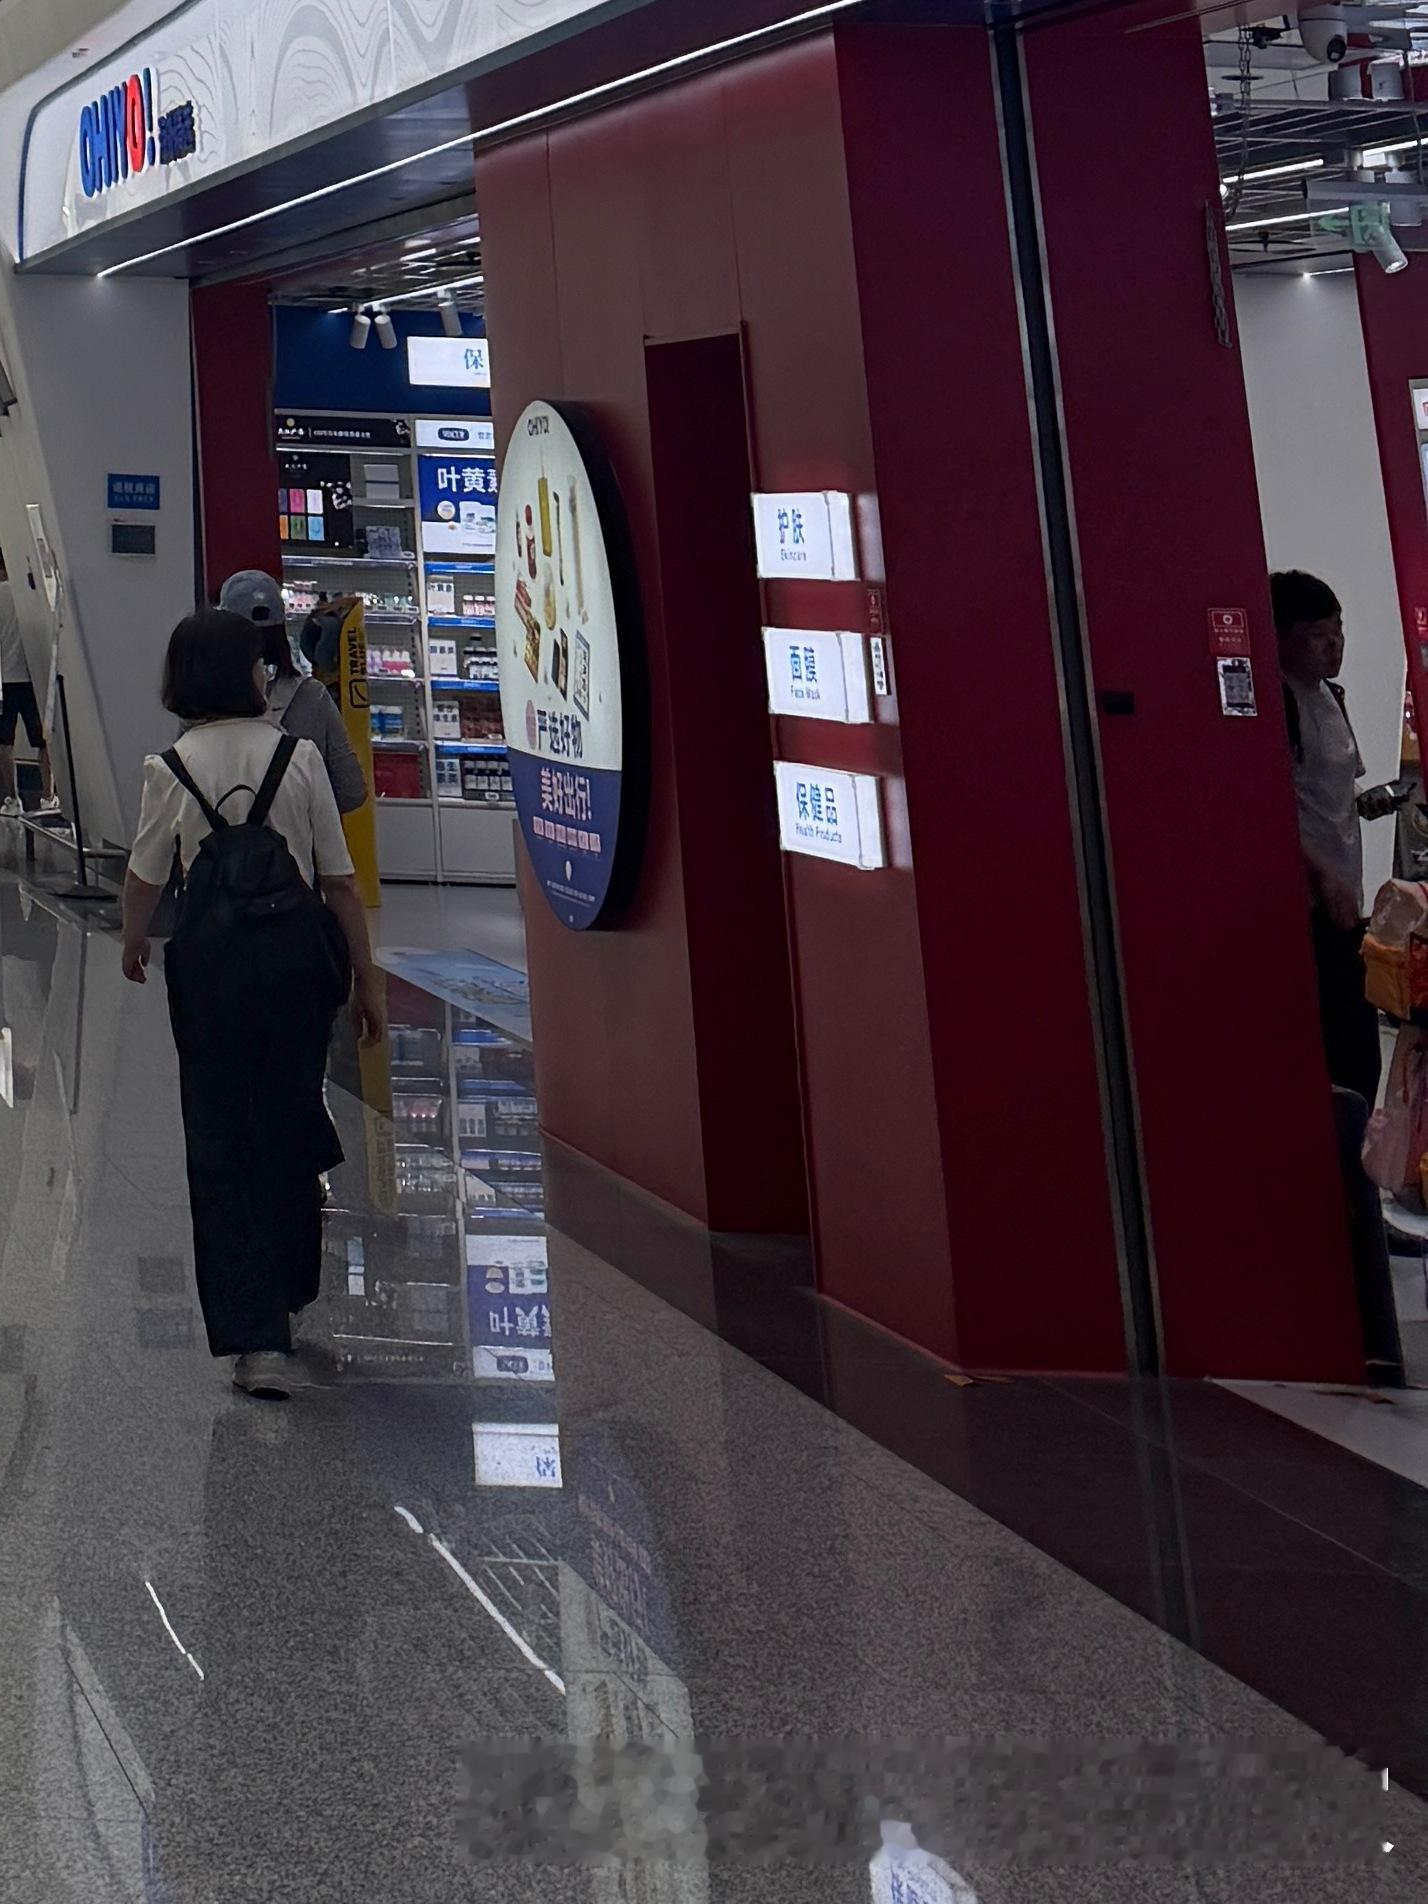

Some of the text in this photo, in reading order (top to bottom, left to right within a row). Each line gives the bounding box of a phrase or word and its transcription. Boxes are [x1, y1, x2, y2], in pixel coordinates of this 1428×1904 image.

[777, 508, 805, 544] 护肤
[796, 782, 838, 827] 保健品
